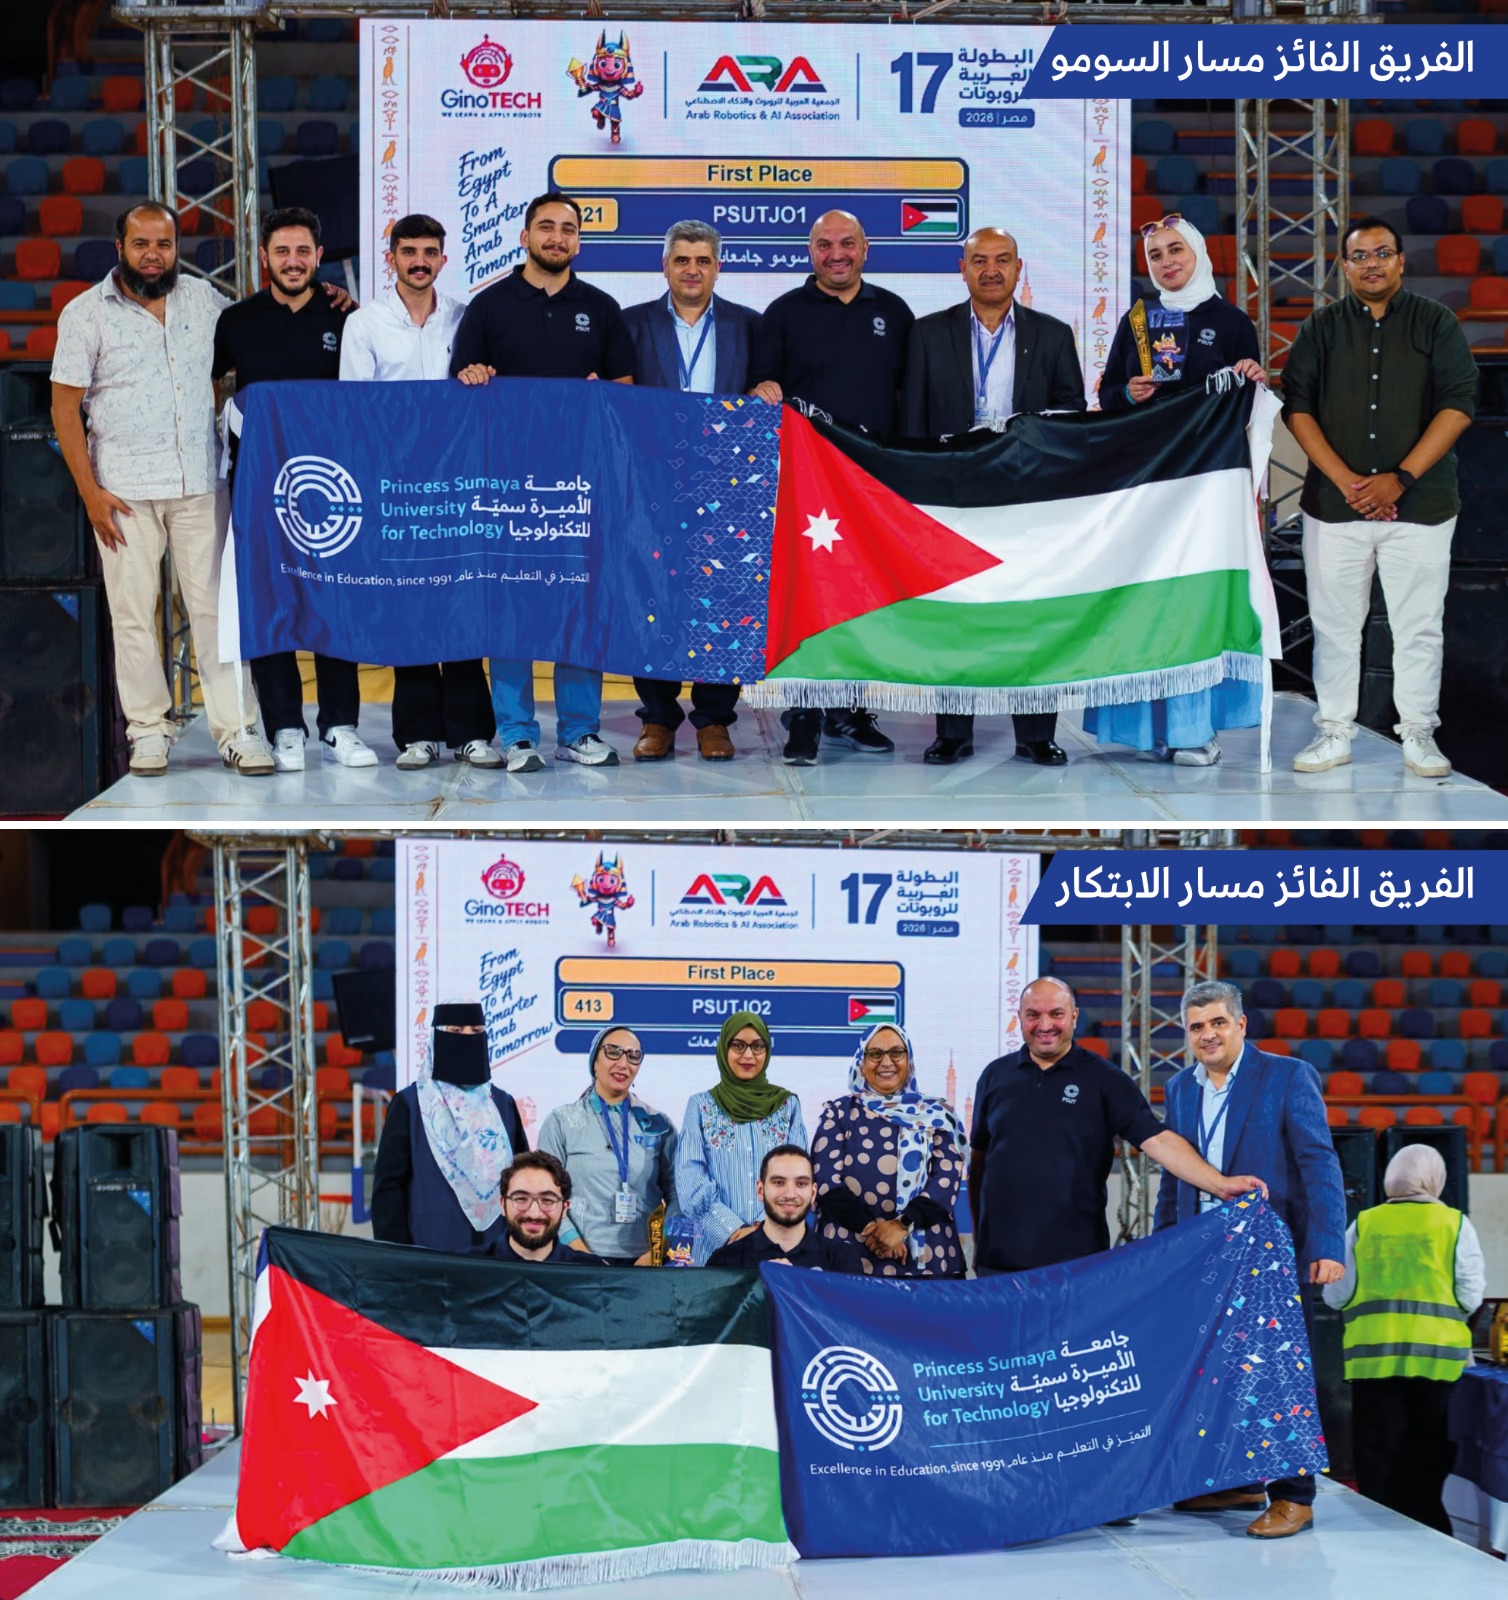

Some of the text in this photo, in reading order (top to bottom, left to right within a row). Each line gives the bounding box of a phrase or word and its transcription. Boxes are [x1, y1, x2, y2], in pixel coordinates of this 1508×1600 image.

[958, 48, 1033, 68] البطولة
[697, 55, 827, 92] ARA
[891, 52, 953, 113] 17
[441, 89, 541, 108] GinoTECH
[959, 86, 1018, 104] روبوتات
[686, 110, 710, 120] Arab
[714, 110, 756, 120] Robotics
[784, 111, 840, 120] Association
[1002, 113, 1028, 125] مصر
[459, 147, 506, 177] From
[458, 160, 512, 199] Egypt
[708, 165, 813, 182] First Place
[460, 191, 498, 222] To A
[583, 206, 602, 223] 21
[713, 205, 806, 223] PSUTJO1
[462, 201, 528, 243] Smarter
[464, 230, 502, 264] Arab
[465, 246, 527, 284] Tomorr
[380, 476, 520, 494] Princess Sumaya
[524, 474, 592, 495] جامعة
[381, 500, 466, 518] University
[530, 494, 591, 518] الأميرة
[381, 519, 504, 540] for Technology
[509, 520, 591, 541] للتكنولوجيا
[325, 572, 335, 583] in
[338, 573, 395, 587] Education,
[397, 575, 425, 586] since
[428, 574, 452, 587] 1991
[455, 569, 474, 583] عام
[477, 568, 497, 579] منذ
[500, 570, 542, 583] التعليم
[544, 570, 556, 587] في
[896, 870, 959, 887] البطولة
[679, 873, 788, 906] ARA
[840, 872, 893, 925] 17
[464, 899, 549, 917] GinoTECH
[897, 902, 959, 917] للروبوتات
[480, 948, 520, 973] From
[479, 959, 524, 992] Egypt
[688, 965, 776, 981] First Place
[481, 985, 513, 1011] To A
[574, 998, 602, 1013] 413
[692, 999, 772, 1015] PSUTJO2
[484, 994, 538, 1028] Smarter
[488, 1018, 517, 1043] Arab
[488, 1021, 554, 1063] Tomorrow
[1060, 1330, 1130, 1357] جامعة
[913, 1349, 1057, 1378] Princess Sumaya
[1070, 1350, 1136, 1383] الأميرة
[918, 1381, 1005, 1402] University
[1054, 1374, 1141, 1413] للتكنولوجيا
[923, 1400, 1050, 1427] for Technology
[1056, 1438, 1099, 1463] التعليم
[1102, 1434, 1114, 1453] في
[1007, 1453, 1028, 1468] عام
[1030, 1451, 1053, 1463] منذ
[810, 1459, 1005, 1477] Excellence in Education, since 1991
